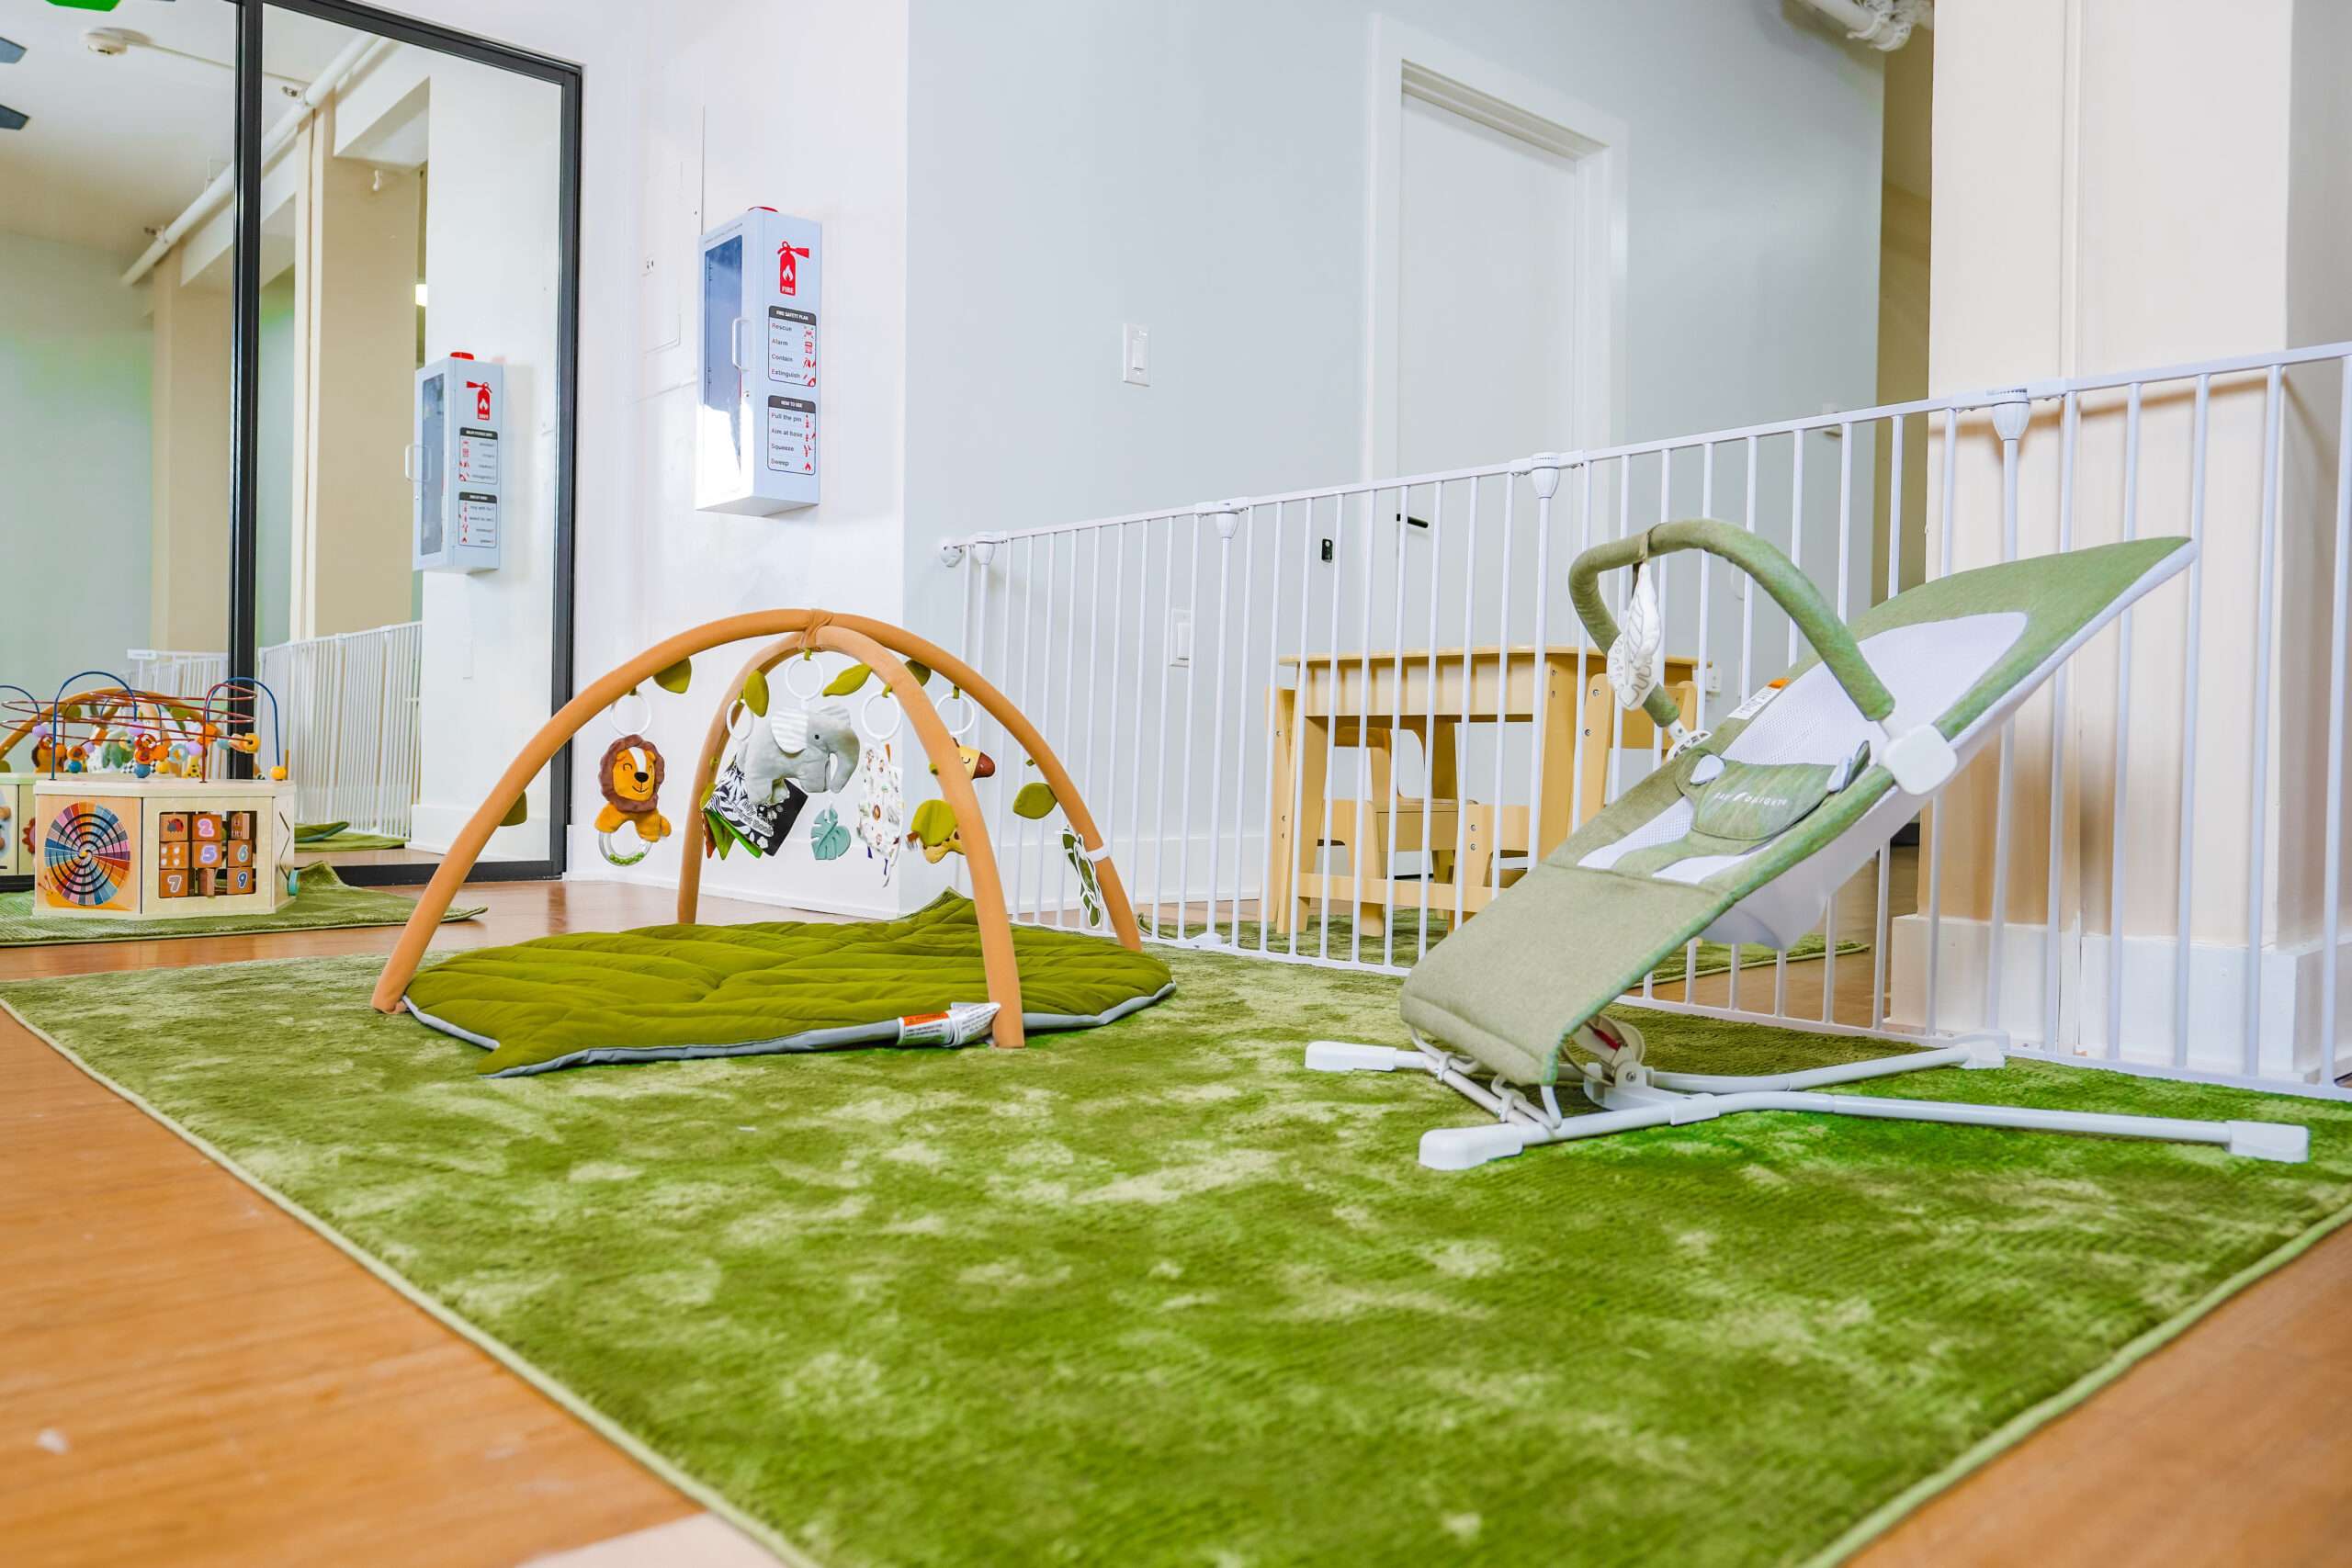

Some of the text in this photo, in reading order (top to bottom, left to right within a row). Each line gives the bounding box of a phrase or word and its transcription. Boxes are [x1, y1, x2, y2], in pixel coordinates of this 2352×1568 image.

[772, 322, 792, 332] Rescue
[772, 338, 788, 346] Alarm
[772, 353, 793, 362] Contain
[771, 368, 801, 378] Extinguish
[771, 443, 795, 452] Squeeze
[771, 457, 789, 467] Sweep
[198, 818, 215, 838] 2
[200, 845, 217, 863] 5
[238, 845, 248, 863] 6
[167, 874, 182, 893] 7
[237, 872, 248, 889] 9
